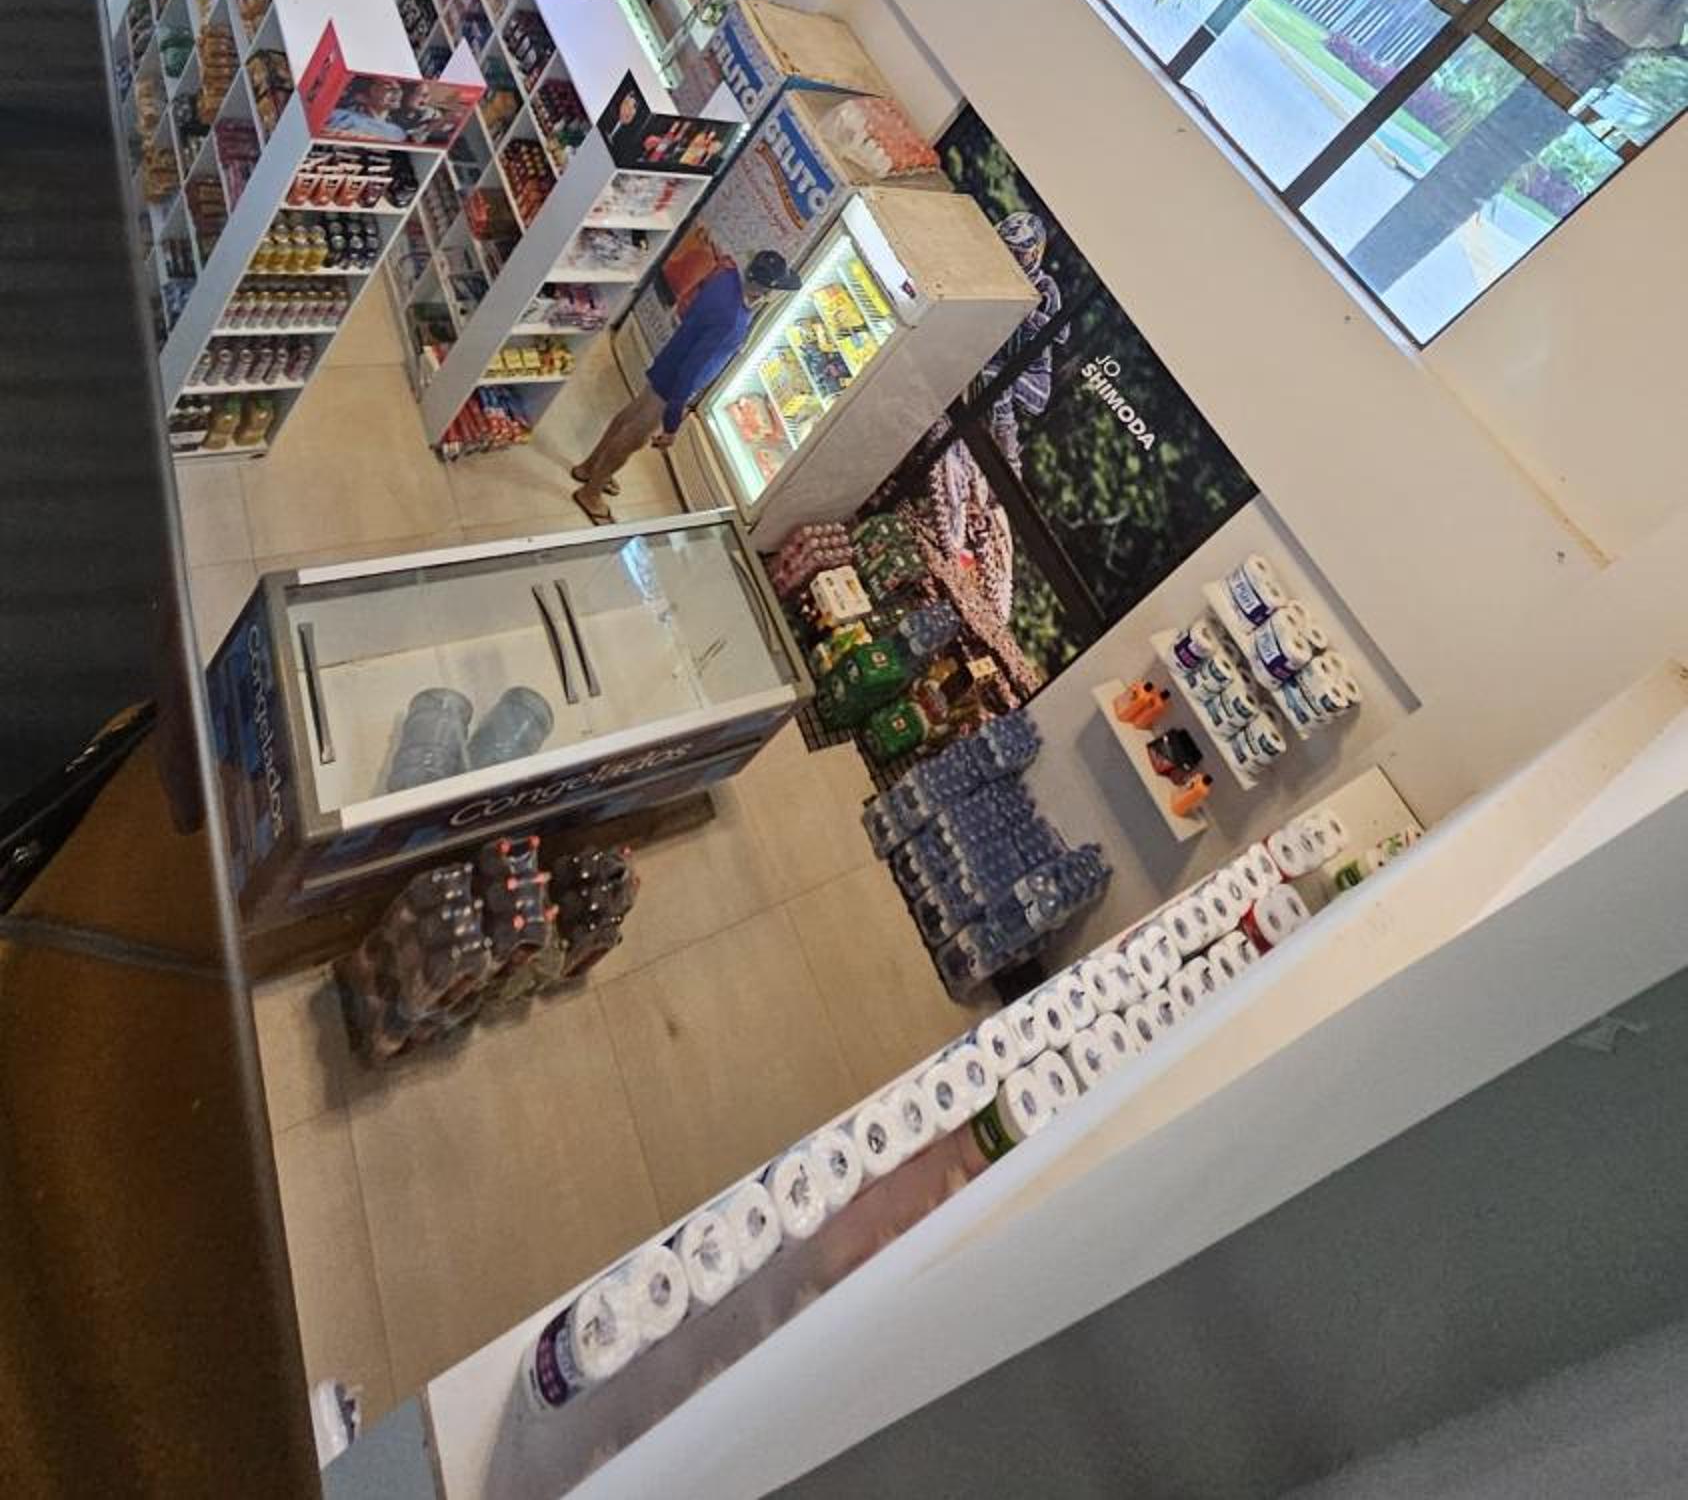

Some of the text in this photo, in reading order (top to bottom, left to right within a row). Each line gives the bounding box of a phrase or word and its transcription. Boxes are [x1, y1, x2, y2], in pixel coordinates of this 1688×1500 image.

[1081, 363, 1157, 451] SHIMODA
[1095, 355, 1121, 377] JO
[248, 624, 285, 840] Congelados
[449, 743, 693, 826] Congelados
